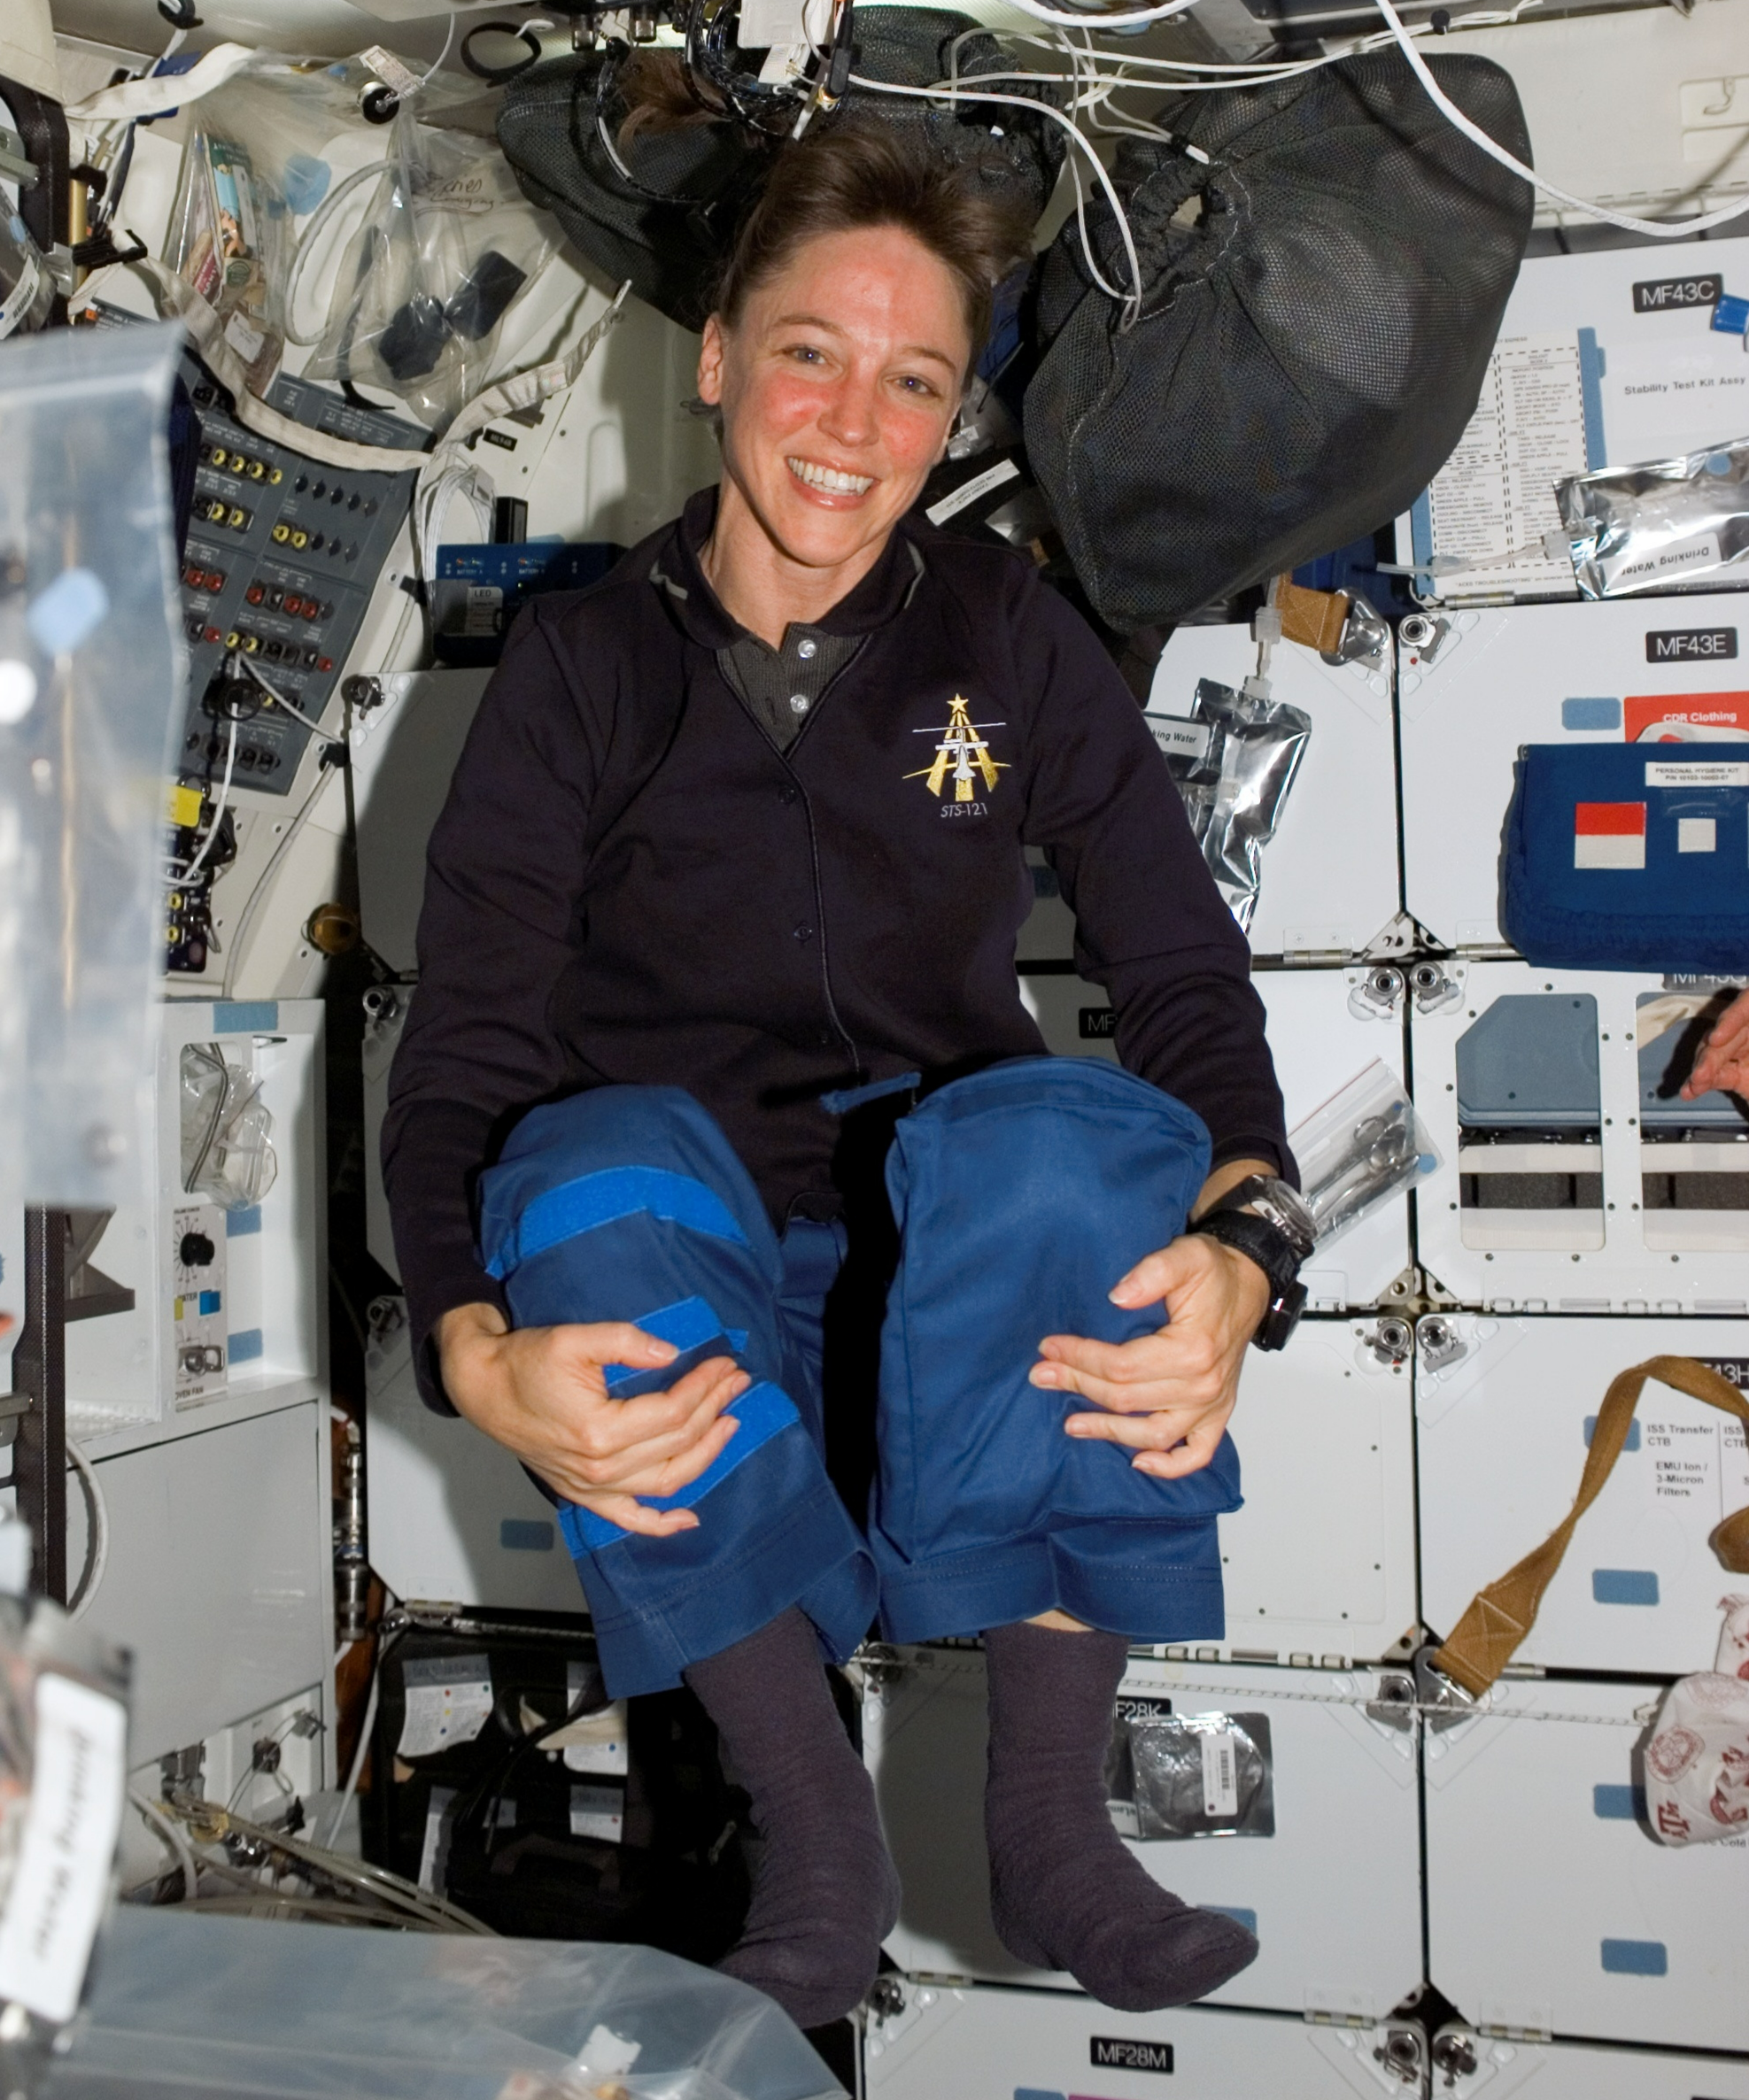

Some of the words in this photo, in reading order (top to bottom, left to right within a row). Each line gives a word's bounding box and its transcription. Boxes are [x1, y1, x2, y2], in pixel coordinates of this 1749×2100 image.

[1642, 280, 1714, 306] MF43C
[1624, 383, 1668, 395] Stability
[1673, 380, 1695, 390] Test
[1699, 377, 1714, 388] Kit
[1719, 376, 1745, 386] Assy
[1660, 546, 1709, 566] Drinking
[1621, 561, 1655, 576] Water
[474, 589, 491, 598] LED
[1656, 634, 1727, 657] MF43E
[1662, 713, 1689, 722] CDR
[1690, 711, 1737, 723] Clothing
[1173, 731, 1197, 744] Water
[940, 802, 988, 818] STS-121
[1647, 1424, 1666, 1434] ISS
[1669, 1424, 1714, 1435] Transfer
[1647, 1437, 1672, 1448] CTB
[1656, 1461, 1682, 1471] EMU
[1684, 1462, 1702, 1471] Ion
[1657, 1486, 1691, 1497] Filters
[1114, 1700, 1162, 1718] F28K
[1098, 2040, 1166, 2070] MF28M
